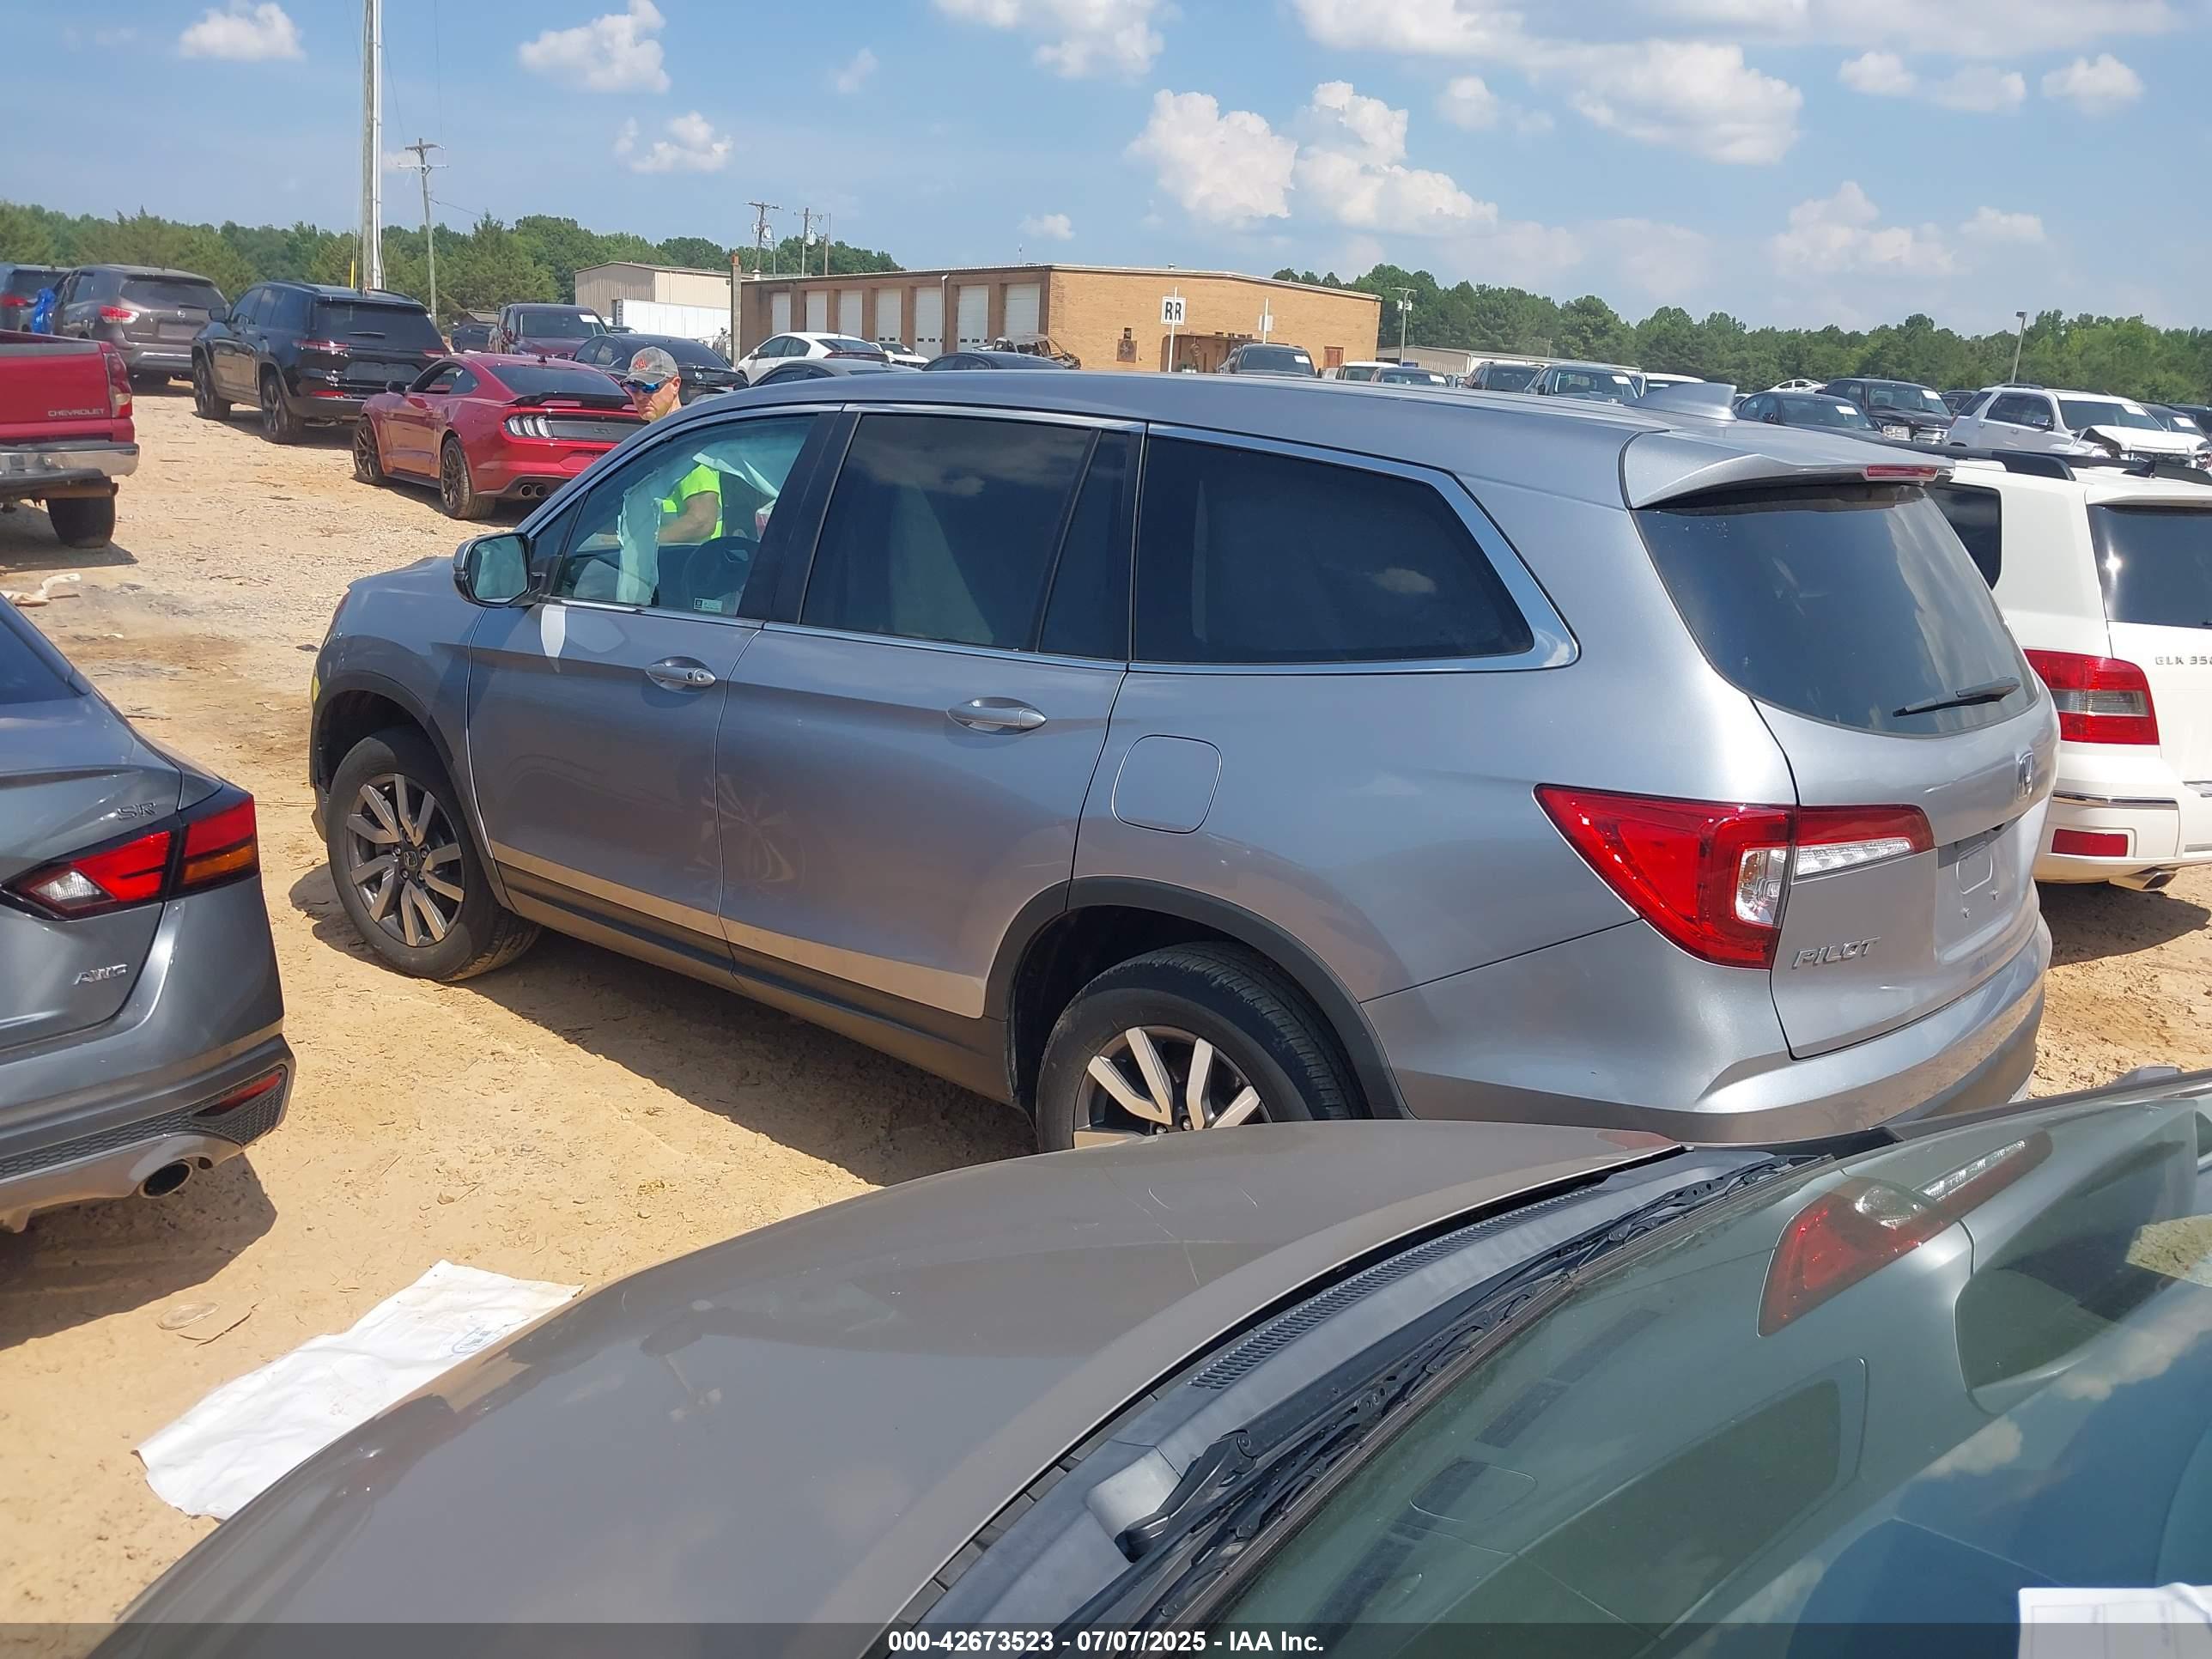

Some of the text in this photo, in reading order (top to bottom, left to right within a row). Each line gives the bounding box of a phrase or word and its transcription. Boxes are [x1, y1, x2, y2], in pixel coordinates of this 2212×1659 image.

[1164, 301, 1182, 321] RR
[47, 408, 105, 417] CHEVROLET
[2155, 656, 2184, 665] GLK
[117, 802, 157, 821] SR
[1791, 936, 1881, 969] PILOT
